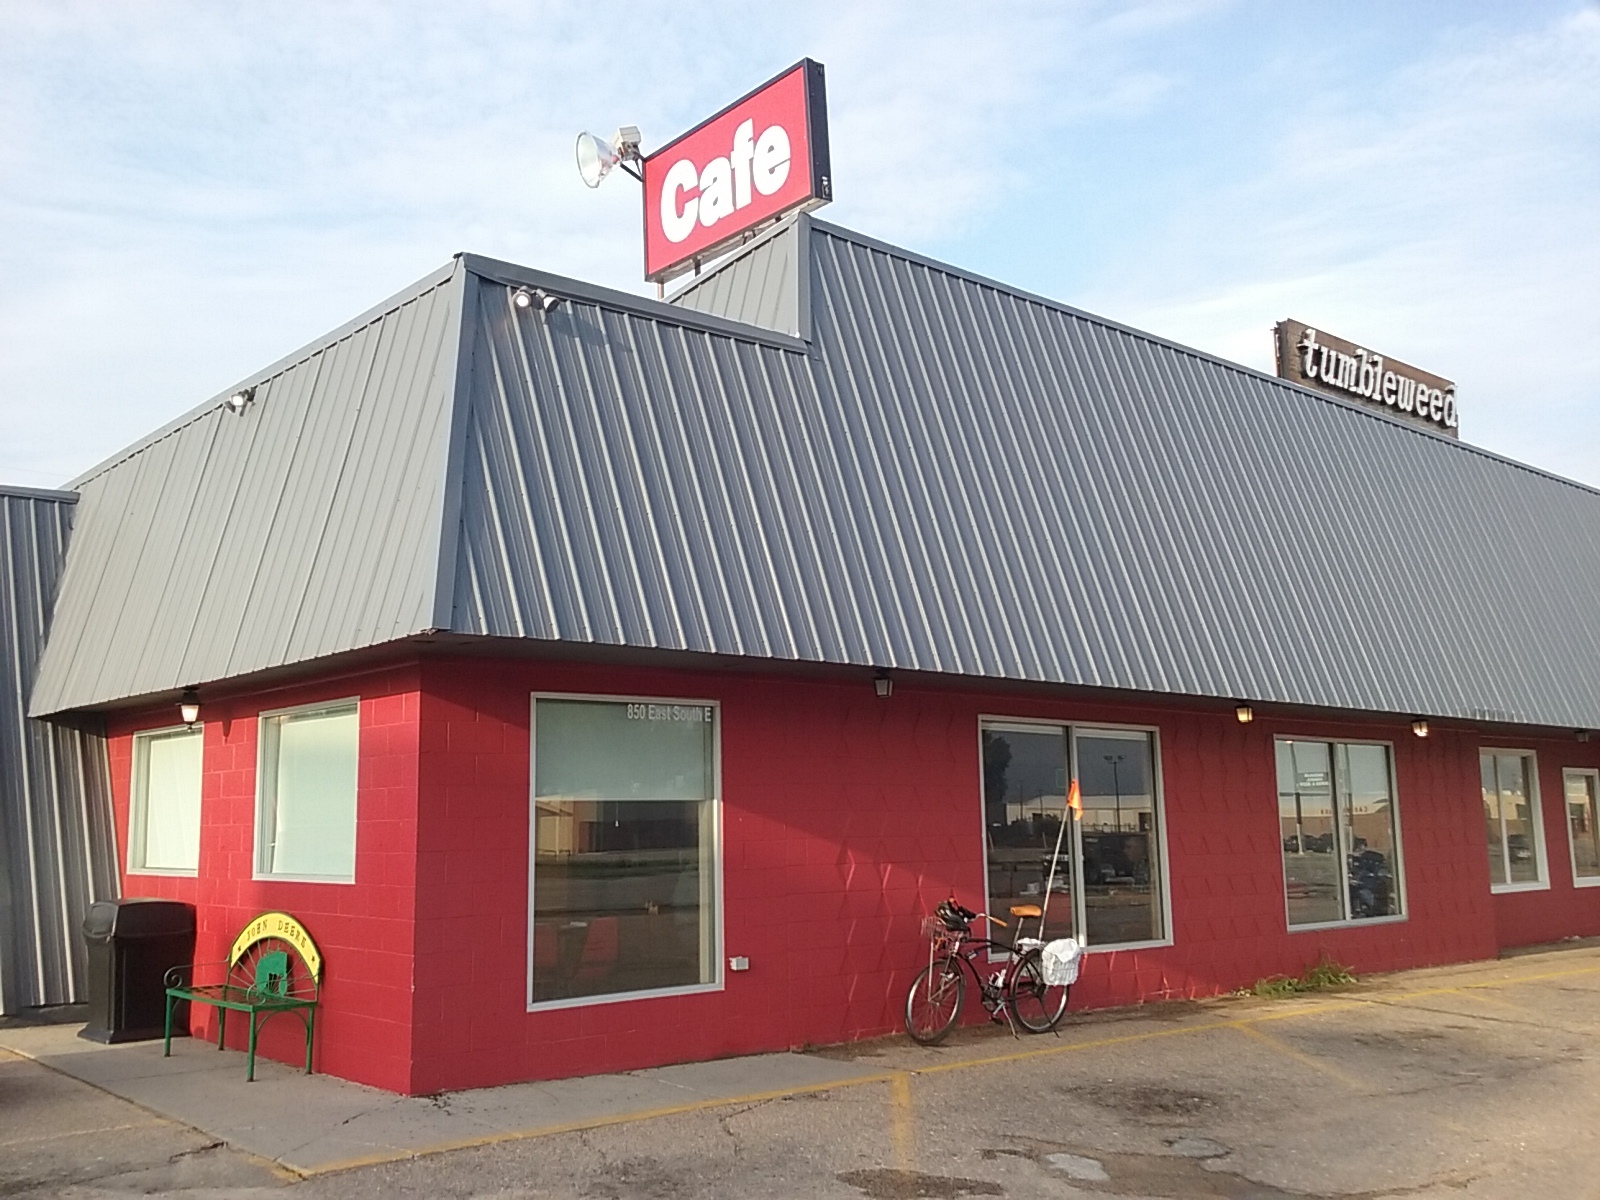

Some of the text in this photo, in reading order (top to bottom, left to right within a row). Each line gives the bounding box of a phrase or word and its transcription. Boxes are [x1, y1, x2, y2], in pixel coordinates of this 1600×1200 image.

[660, 117, 791, 243] Cafe
[1297, 328, 1458, 428] tumbleweed
[627, 703, 712, 722] 850 East South E
[246, 919, 307, 949] JOHN DEERE
